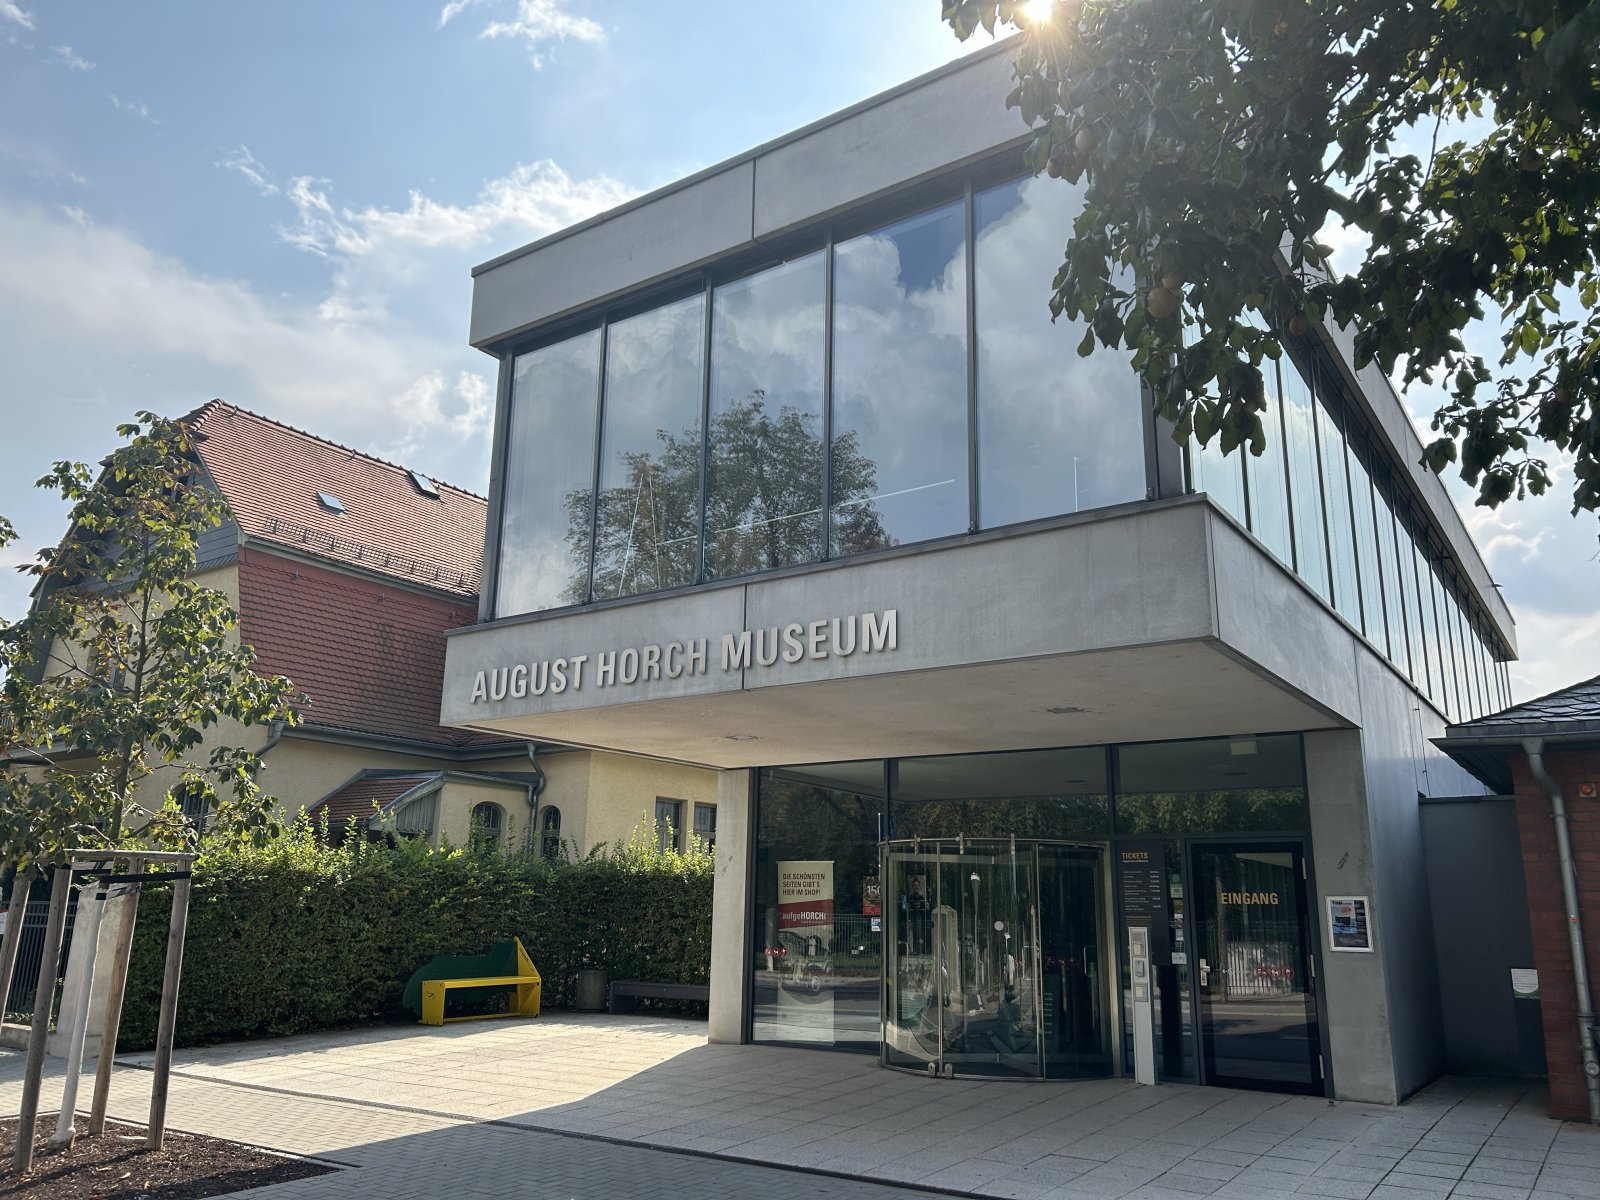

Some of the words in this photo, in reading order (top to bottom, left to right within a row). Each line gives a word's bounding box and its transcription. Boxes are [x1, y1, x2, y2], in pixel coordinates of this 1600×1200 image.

[470, 655, 588, 703] AUGUST
[596, 638, 707, 687] HORCH
[721, 609, 898, 671] MUSEUM
[793, 872, 826, 880] SCHÖNSTEN
[1221, 892, 1279, 905] EINGANG
